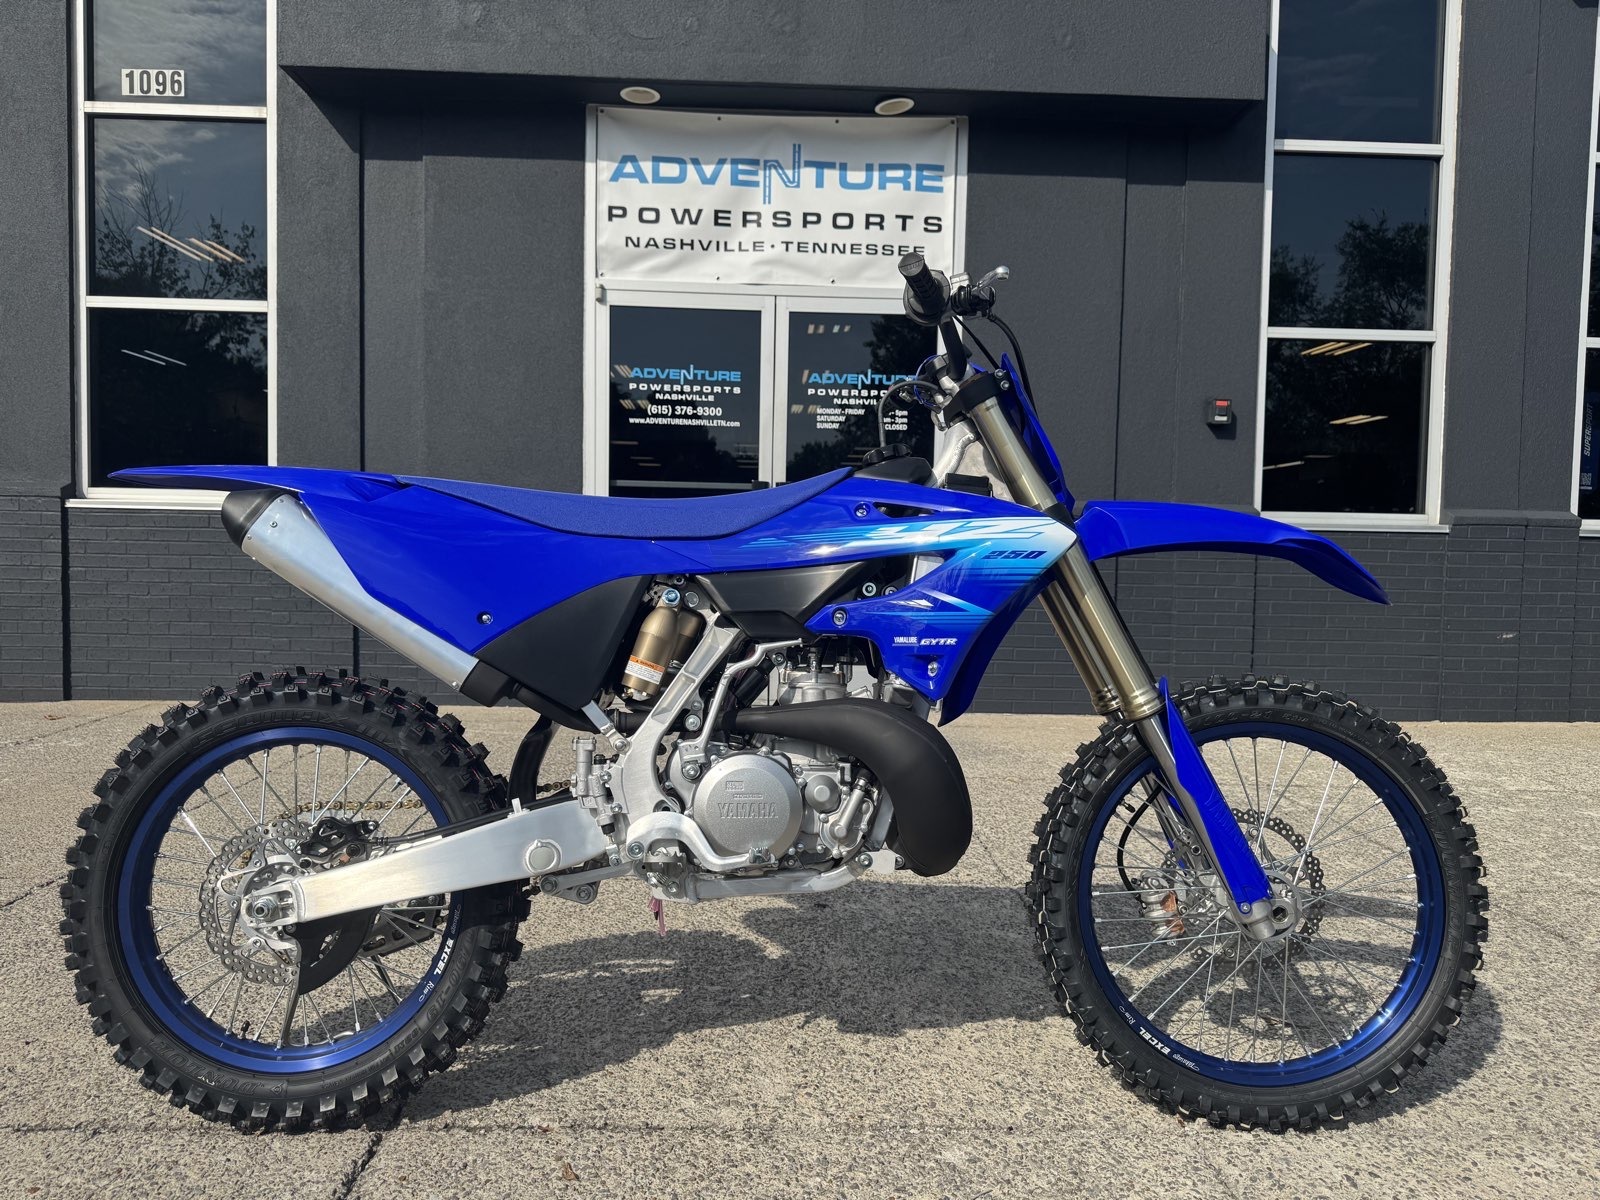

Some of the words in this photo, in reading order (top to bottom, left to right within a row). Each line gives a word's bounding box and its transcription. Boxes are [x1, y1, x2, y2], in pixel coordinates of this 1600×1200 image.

[125, 70, 182, 95] 1096
[609, 143, 945, 205] ADVENTURE
[607, 205, 943, 234] POWERSPORTS
[625, 236, 765, 253] NASHVILLE
[781, 240, 925, 257] TENNESSEE
[630, 364, 741, 385] ADVENTURE
[809, 369, 916, 390] ADVENTU
[629, 383, 741, 394] POWERSPORTS
[655, 393, 714, 402] NASHVILLE
[808, 388, 888, 397] POWERSPO
[647, 404, 672, 416] (615)
[674, 405, 722, 417] 376-9300
[833, 398, 878, 406] NASHVIL
[629, 417, 741, 427] www.ADVENTURENASHVILLETN.com
[1583, 403, 1593, 457] SUPERSPORT
[981, 551, 1048, 560] 250
[894, 636, 917, 644] YAMALUBE
[919, 637, 958, 646] GYTR
[718, 803, 779, 819] YAMAHA
[433, 937, 455, 976] EXCEL
[1140, 1026, 1171, 1056] EXCEL
